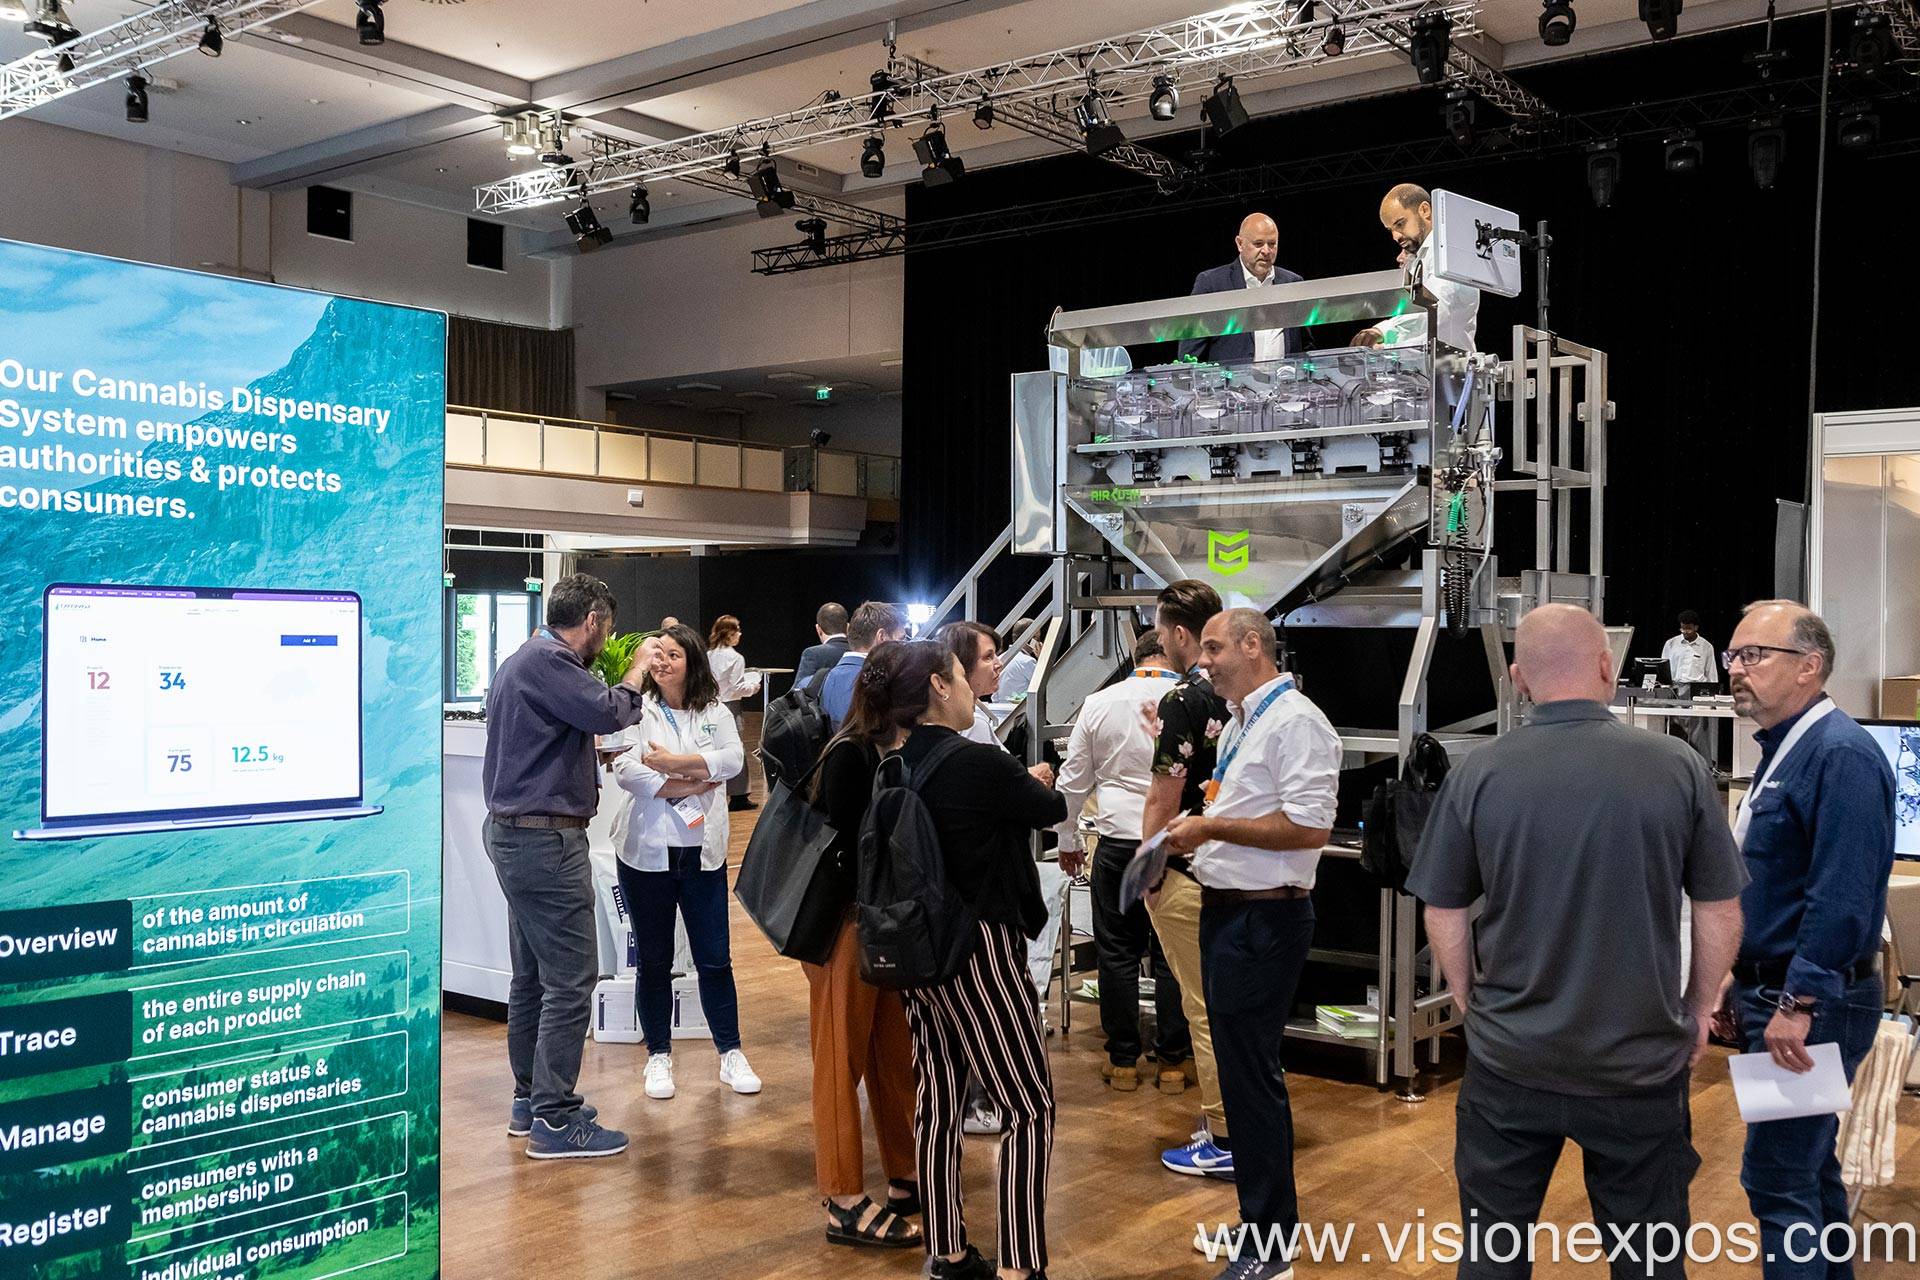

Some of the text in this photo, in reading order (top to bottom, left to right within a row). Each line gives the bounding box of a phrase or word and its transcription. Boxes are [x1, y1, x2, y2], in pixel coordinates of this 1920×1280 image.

[0, 358, 391, 433] Our Cannabis Dispensary
[0, 398, 298, 454] System empowers
[0, 444, 342, 492] authorities & protects
[0, 485, 195, 519] consumers.
[87, 672, 110, 690] 12
[159, 672, 186, 690] 34
[167, 754, 192, 772] 75
[231, 746, 284, 763] 12.5 kg
[143, 892, 308, 929] of the amount of
[143, 910, 364, 954] cannabis in circulation
[0, 927, 117, 957] Overview
[143, 969, 366, 1019] the entire supply chain
[0, 1027, 77, 1056] Trace
[143, 1002, 302, 1044] of each product
[142, 1058, 328, 1109] consumer status &
[141, 1077, 362, 1135] cannabis dispensaries
[0, 1115, 105, 1151] Manage
[141, 1148, 319, 1200] consumers with a
[141, 1173, 294, 1225] membership ID
[0, 1204, 111, 1247] Register
[142, 1215, 369, 1280] individual consumption
